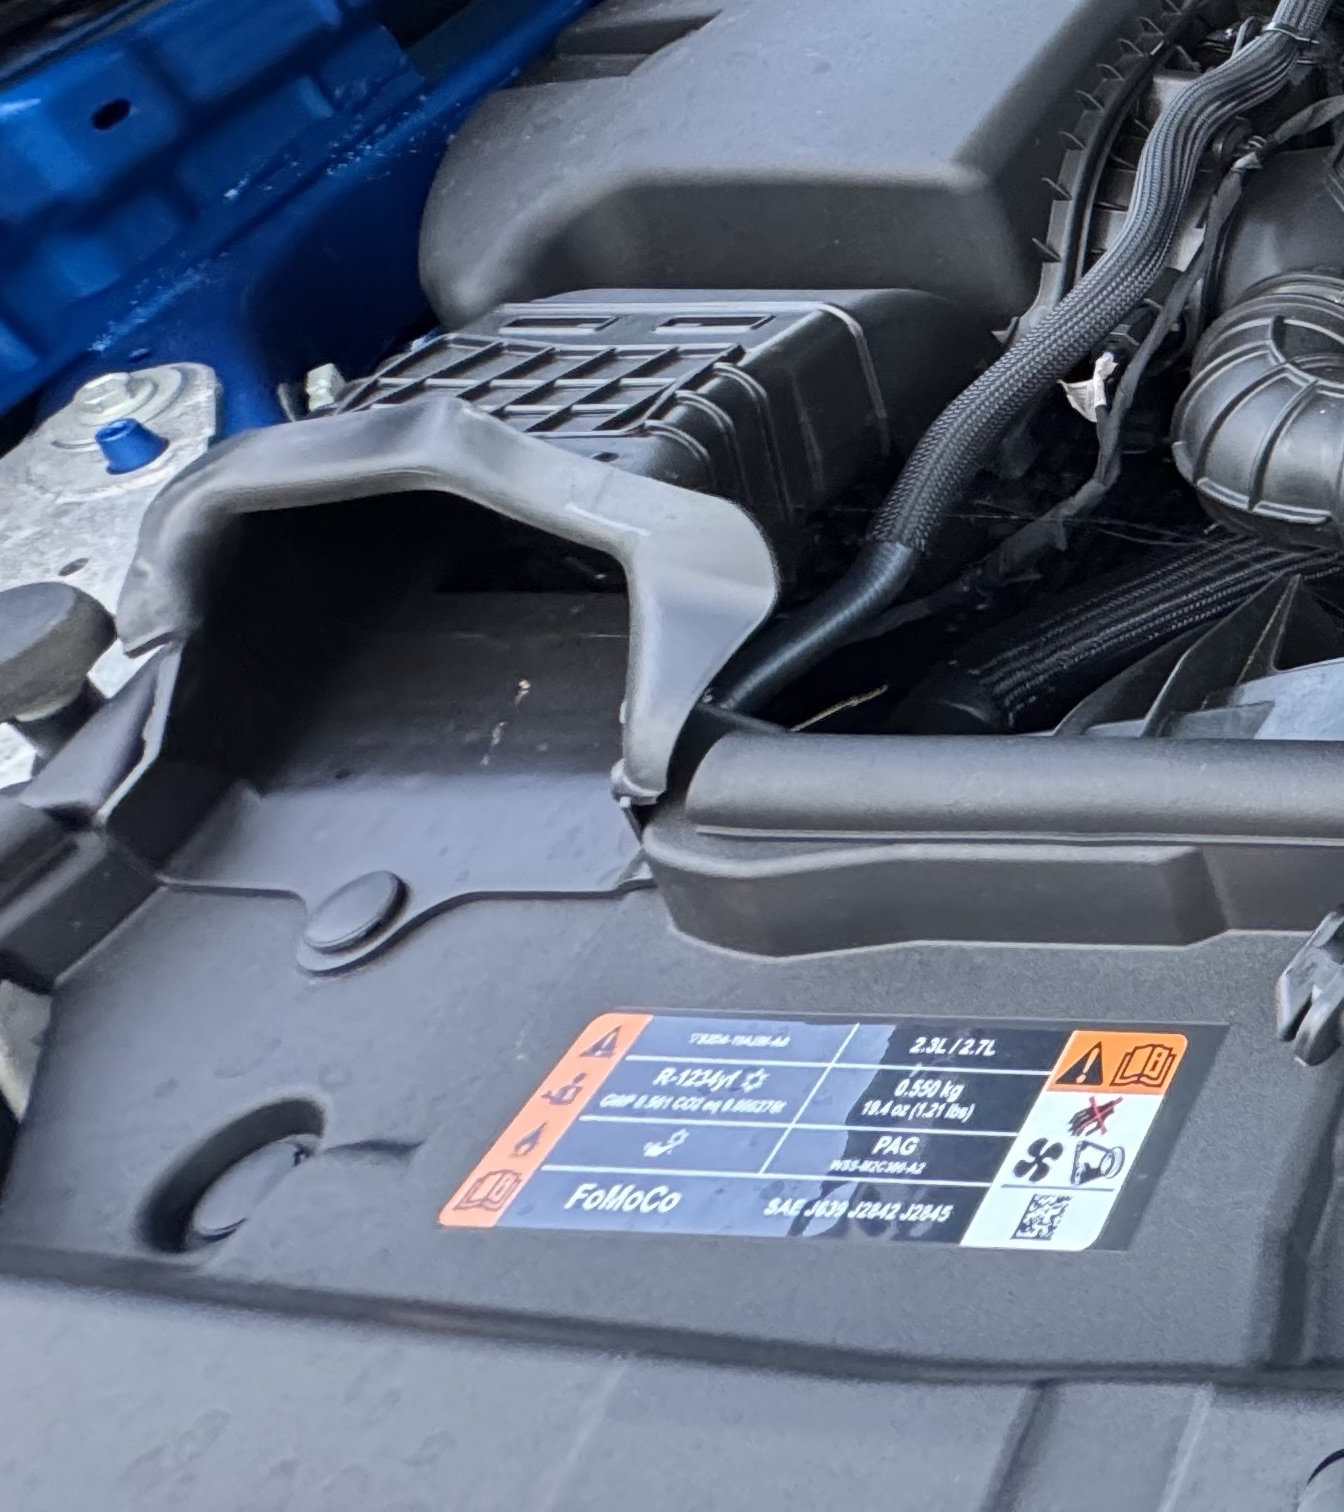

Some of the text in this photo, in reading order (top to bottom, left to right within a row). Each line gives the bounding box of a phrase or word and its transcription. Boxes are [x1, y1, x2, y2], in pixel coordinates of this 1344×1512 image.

[909, 1037, 947, 1055] 2.3L
[958, 1039, 997, 1057] 2.7L
[653, 1067, 742, 1092] R-1234yf
[894, 1078, 966, 1103] 0.550 kg
[861, 1100, 976, 1123] 19.4 oz (1.21 lbs)
[871, 1135, 920, 1156] PAG
[564, 1182, 682, 1214] FoMoCo
[763, 1197, 954, 1224] SAE J639 J2842 J2845
